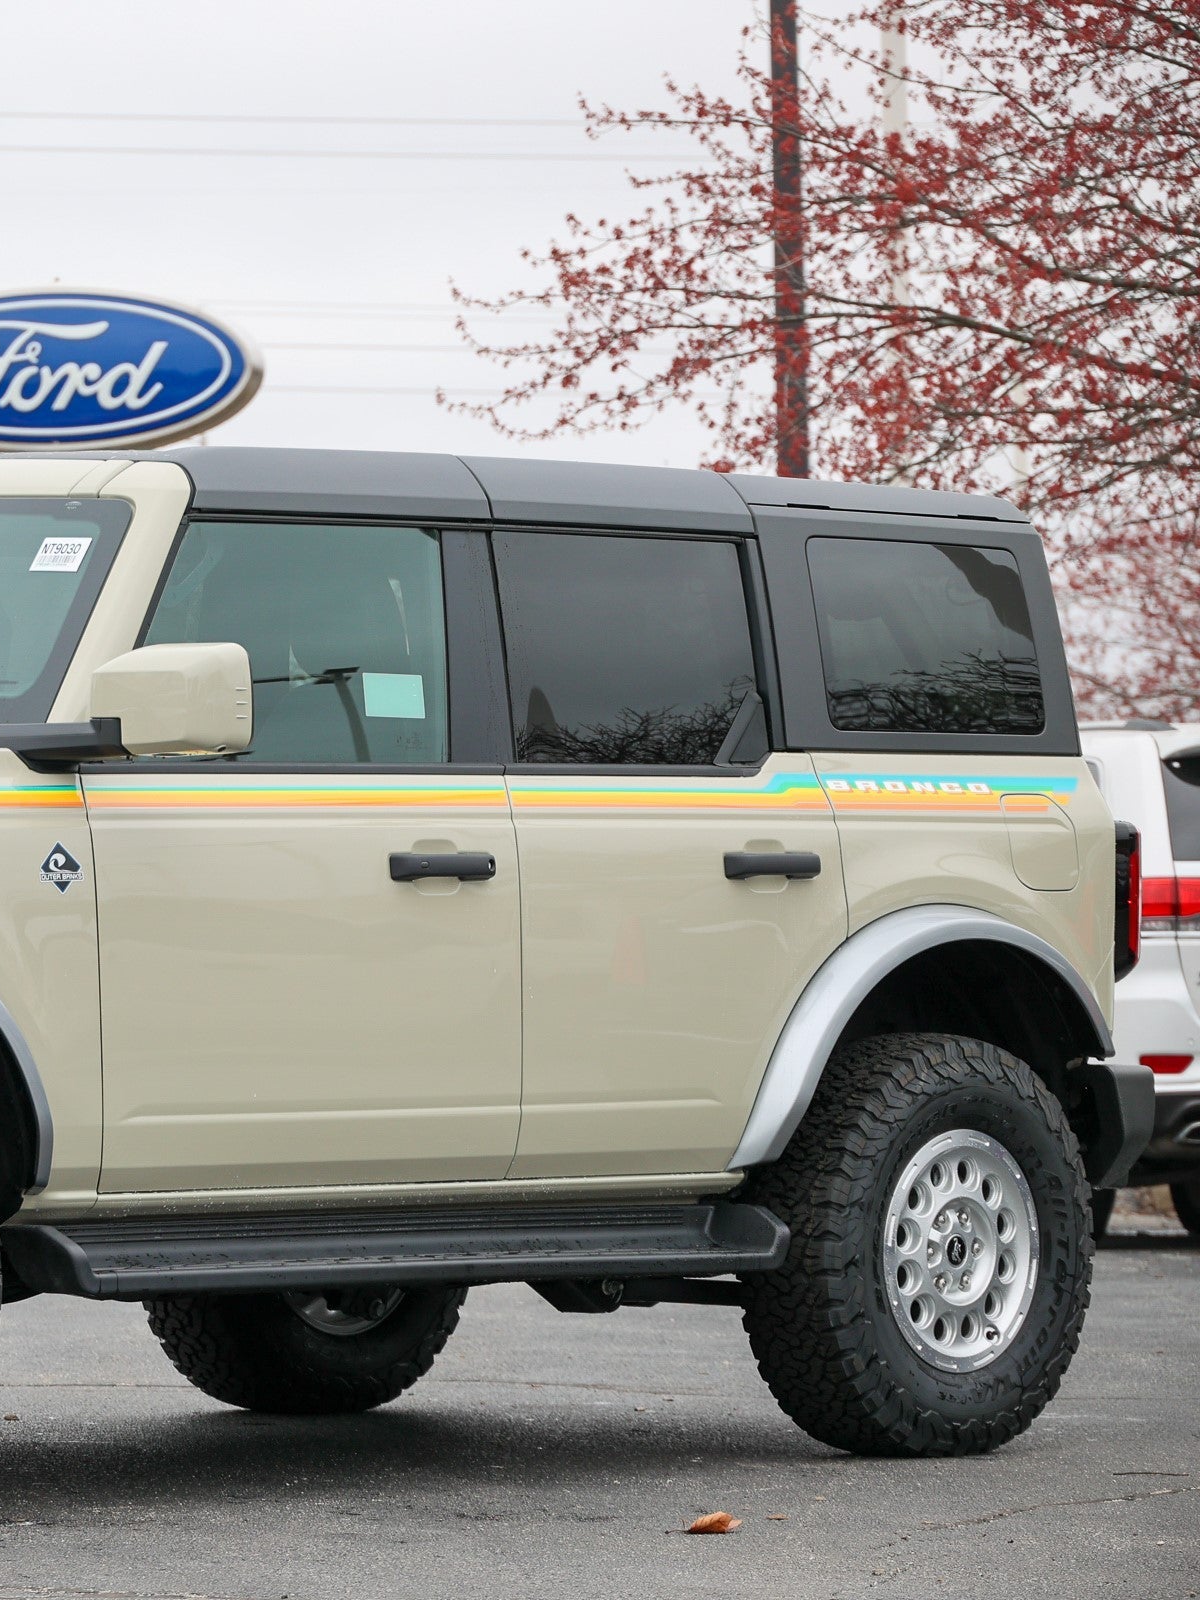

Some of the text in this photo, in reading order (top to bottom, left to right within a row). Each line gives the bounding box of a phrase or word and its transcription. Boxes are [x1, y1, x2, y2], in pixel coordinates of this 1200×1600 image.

[41, 543, 82, 555] NT9030
[826, 779, 993, 795] BRONCO
[41, 872, 83, 881] OUTER BANKS
